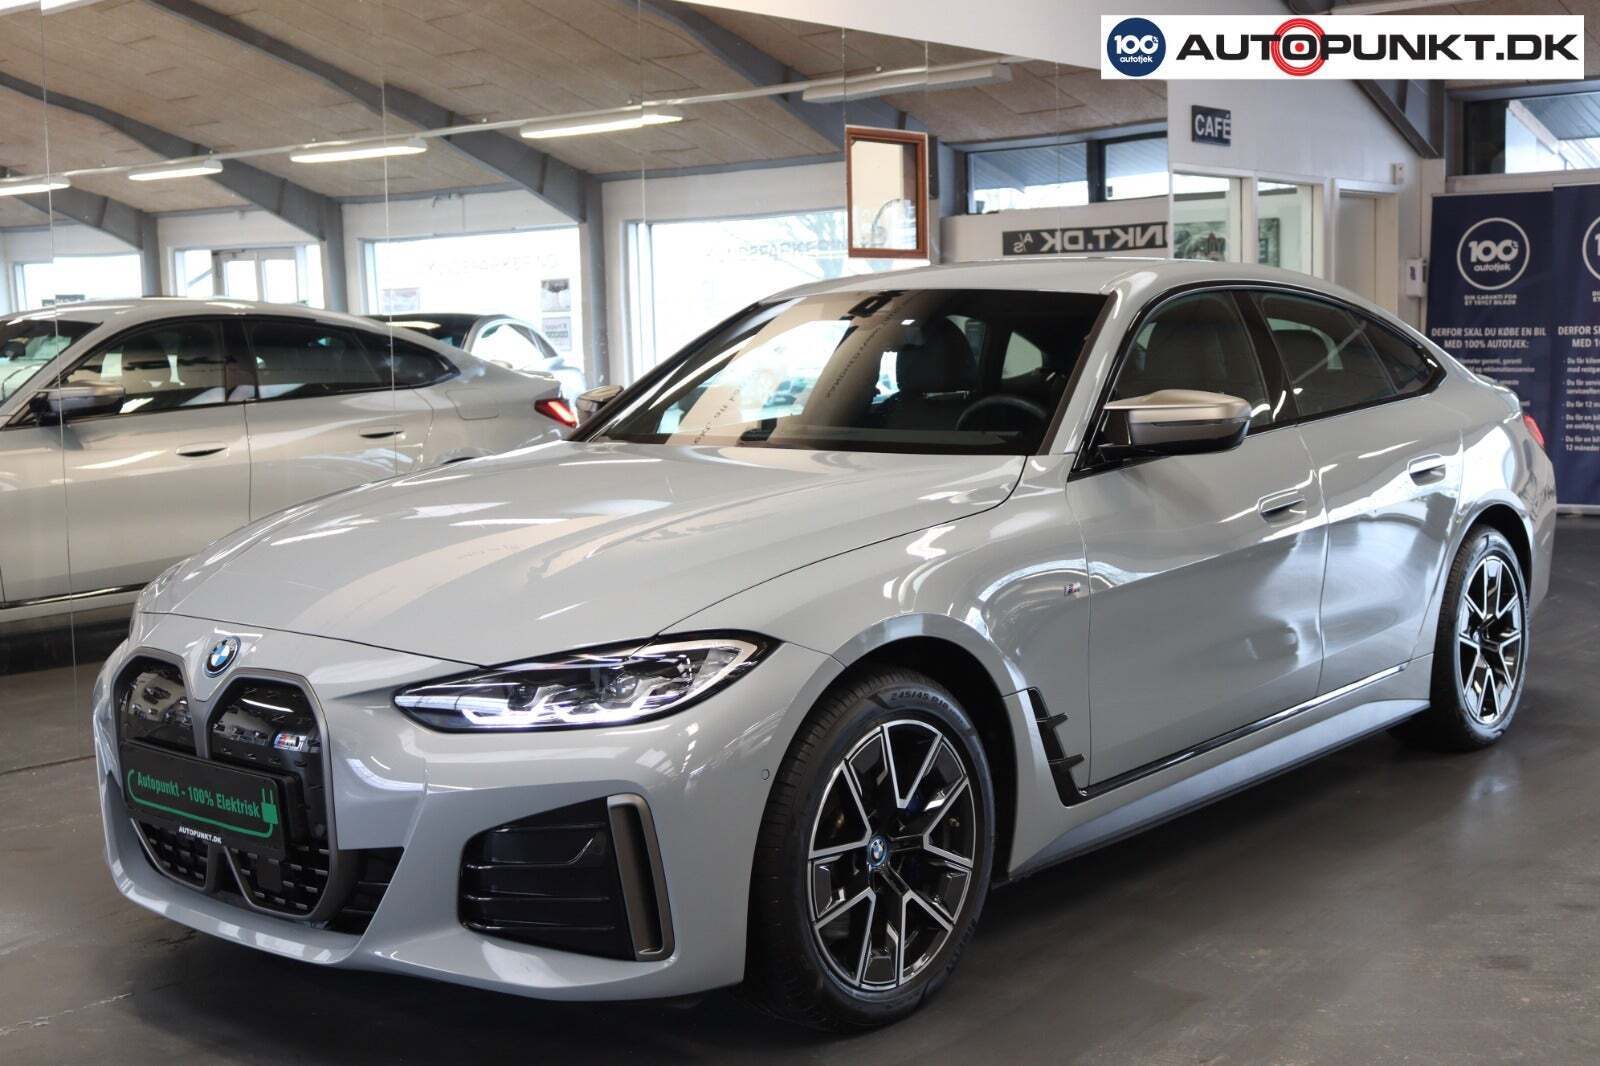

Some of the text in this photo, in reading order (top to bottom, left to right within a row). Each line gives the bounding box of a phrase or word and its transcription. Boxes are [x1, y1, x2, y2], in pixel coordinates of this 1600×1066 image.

[1194, 114, 1232, 139] CAFÉ
[1431, 327, 1546, 336] DERFOR SKAL DU KØBE EN BIL
[1558, 325, 1591, 336] DERFOR
[1444, 339, 1462, 348] MED
[1465, 339, 1486, 348] 100%
[1572, 338, 1591, 348] MED
[137, 771, 180, 797] Autopunkt
[188, 786, 214, 807] 100%
[215, 793, 261, 818] Elektrisk
[178, 826, 222, 844] AUTOPUNKT.DK
